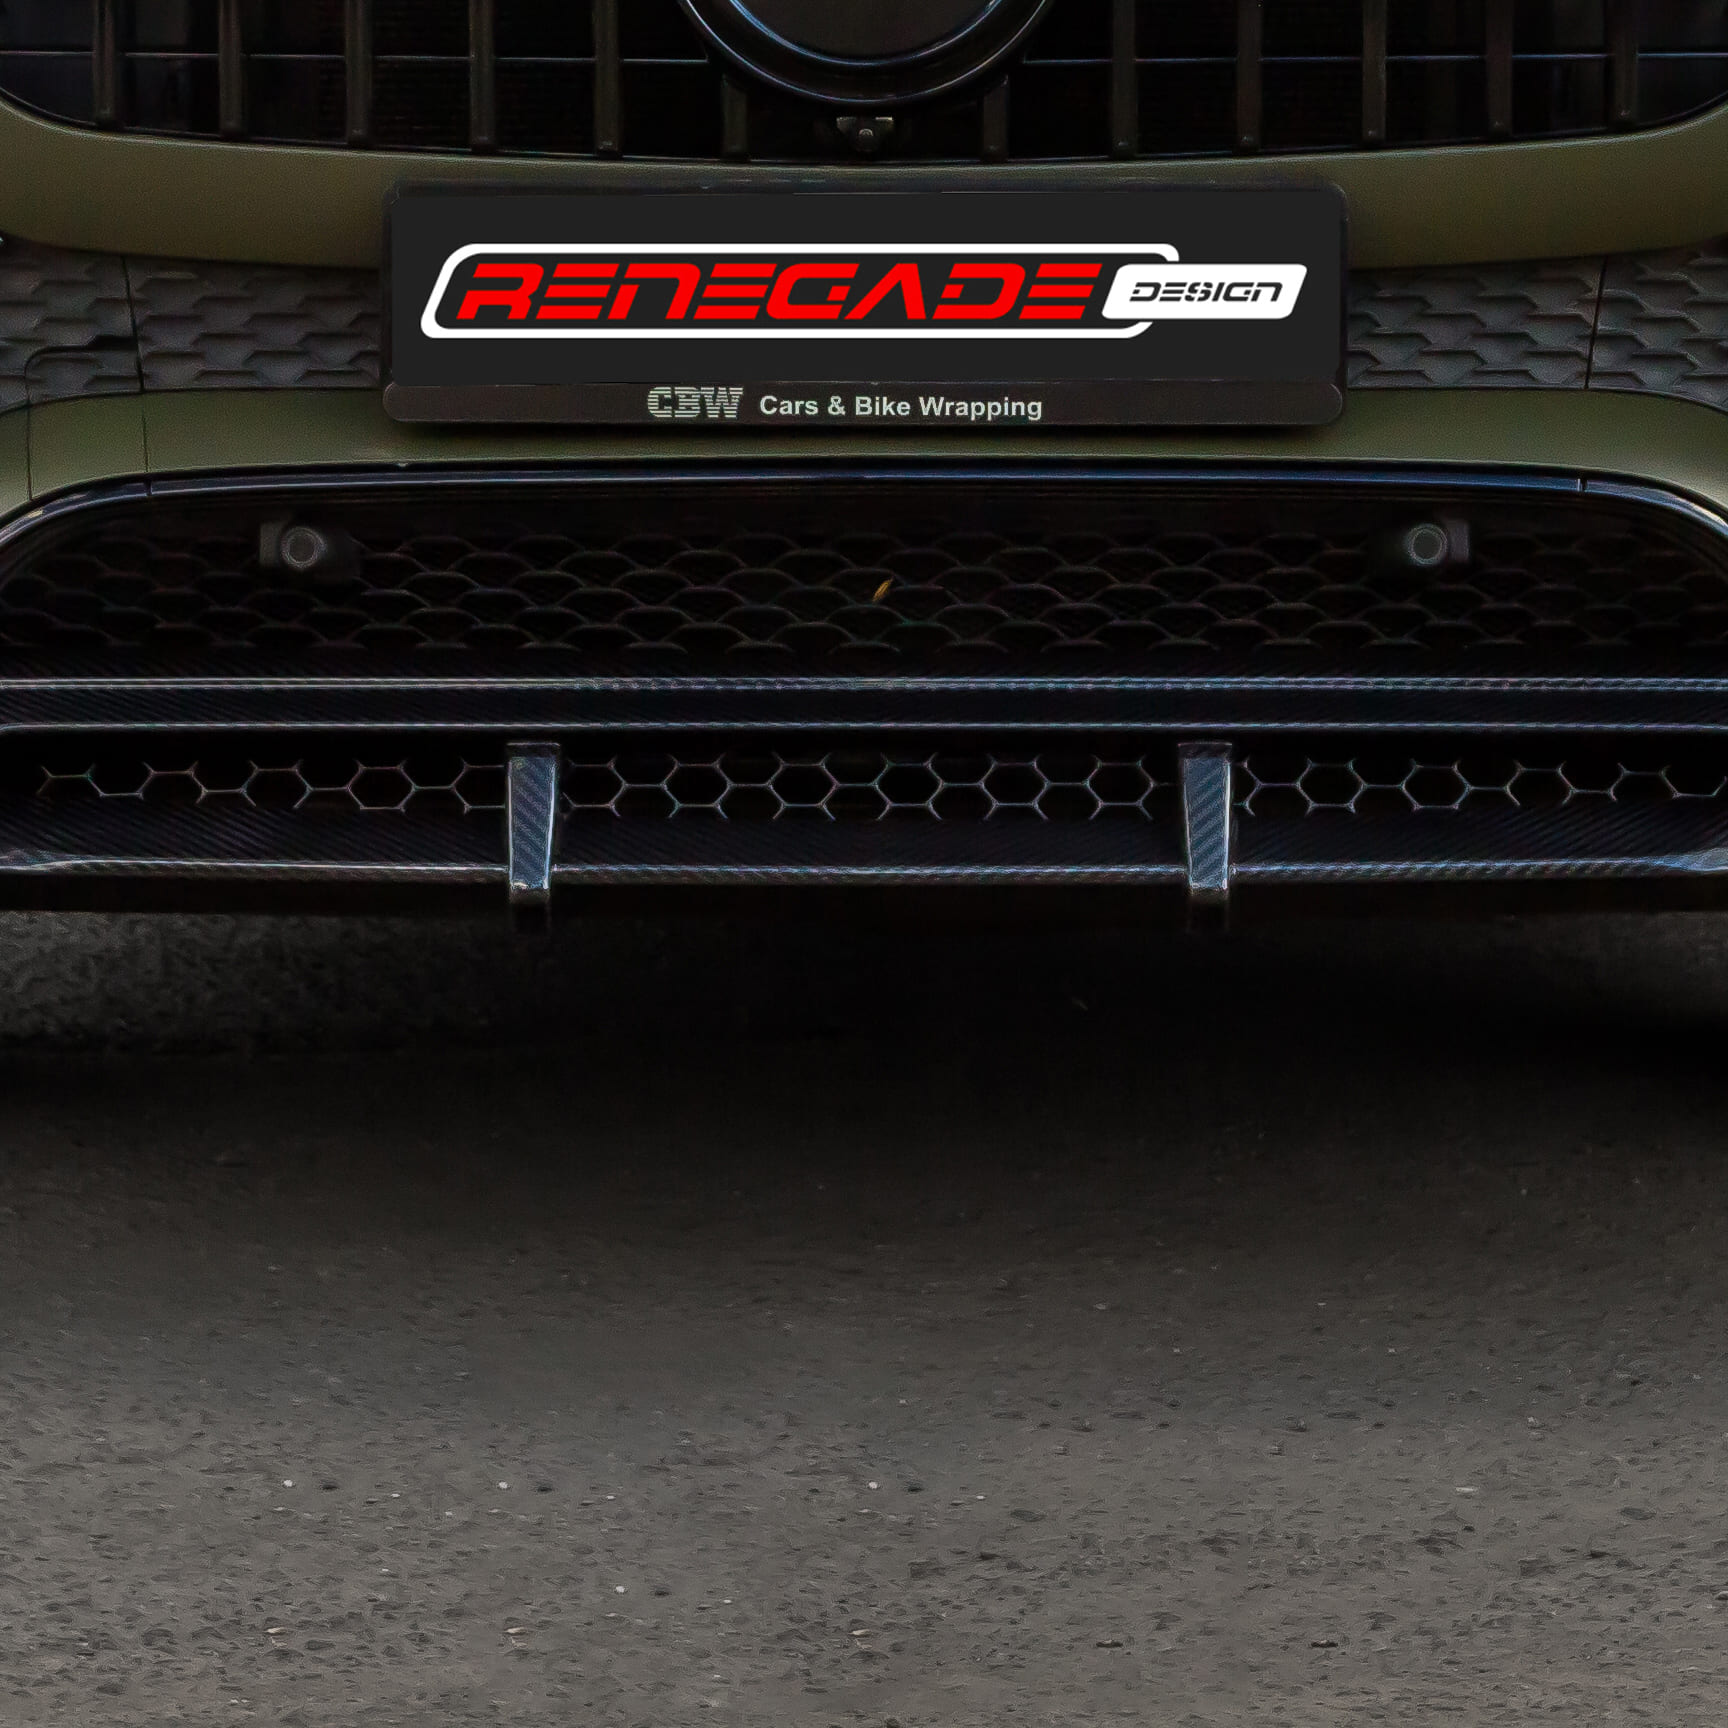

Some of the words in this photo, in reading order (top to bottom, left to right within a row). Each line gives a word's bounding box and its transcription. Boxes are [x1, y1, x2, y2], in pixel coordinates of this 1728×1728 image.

[456, 263, 1103, 320] RENEGADE
[1129, 282, 1283, 302] DESIGN
[647, 386, 744, 418] CBW
[759, 395, 819, 416] Cars
[827, 395, 846, 416] &
[855, 396, 911, 416] Bike
[918, 396, 1042, 422] Wrapping
